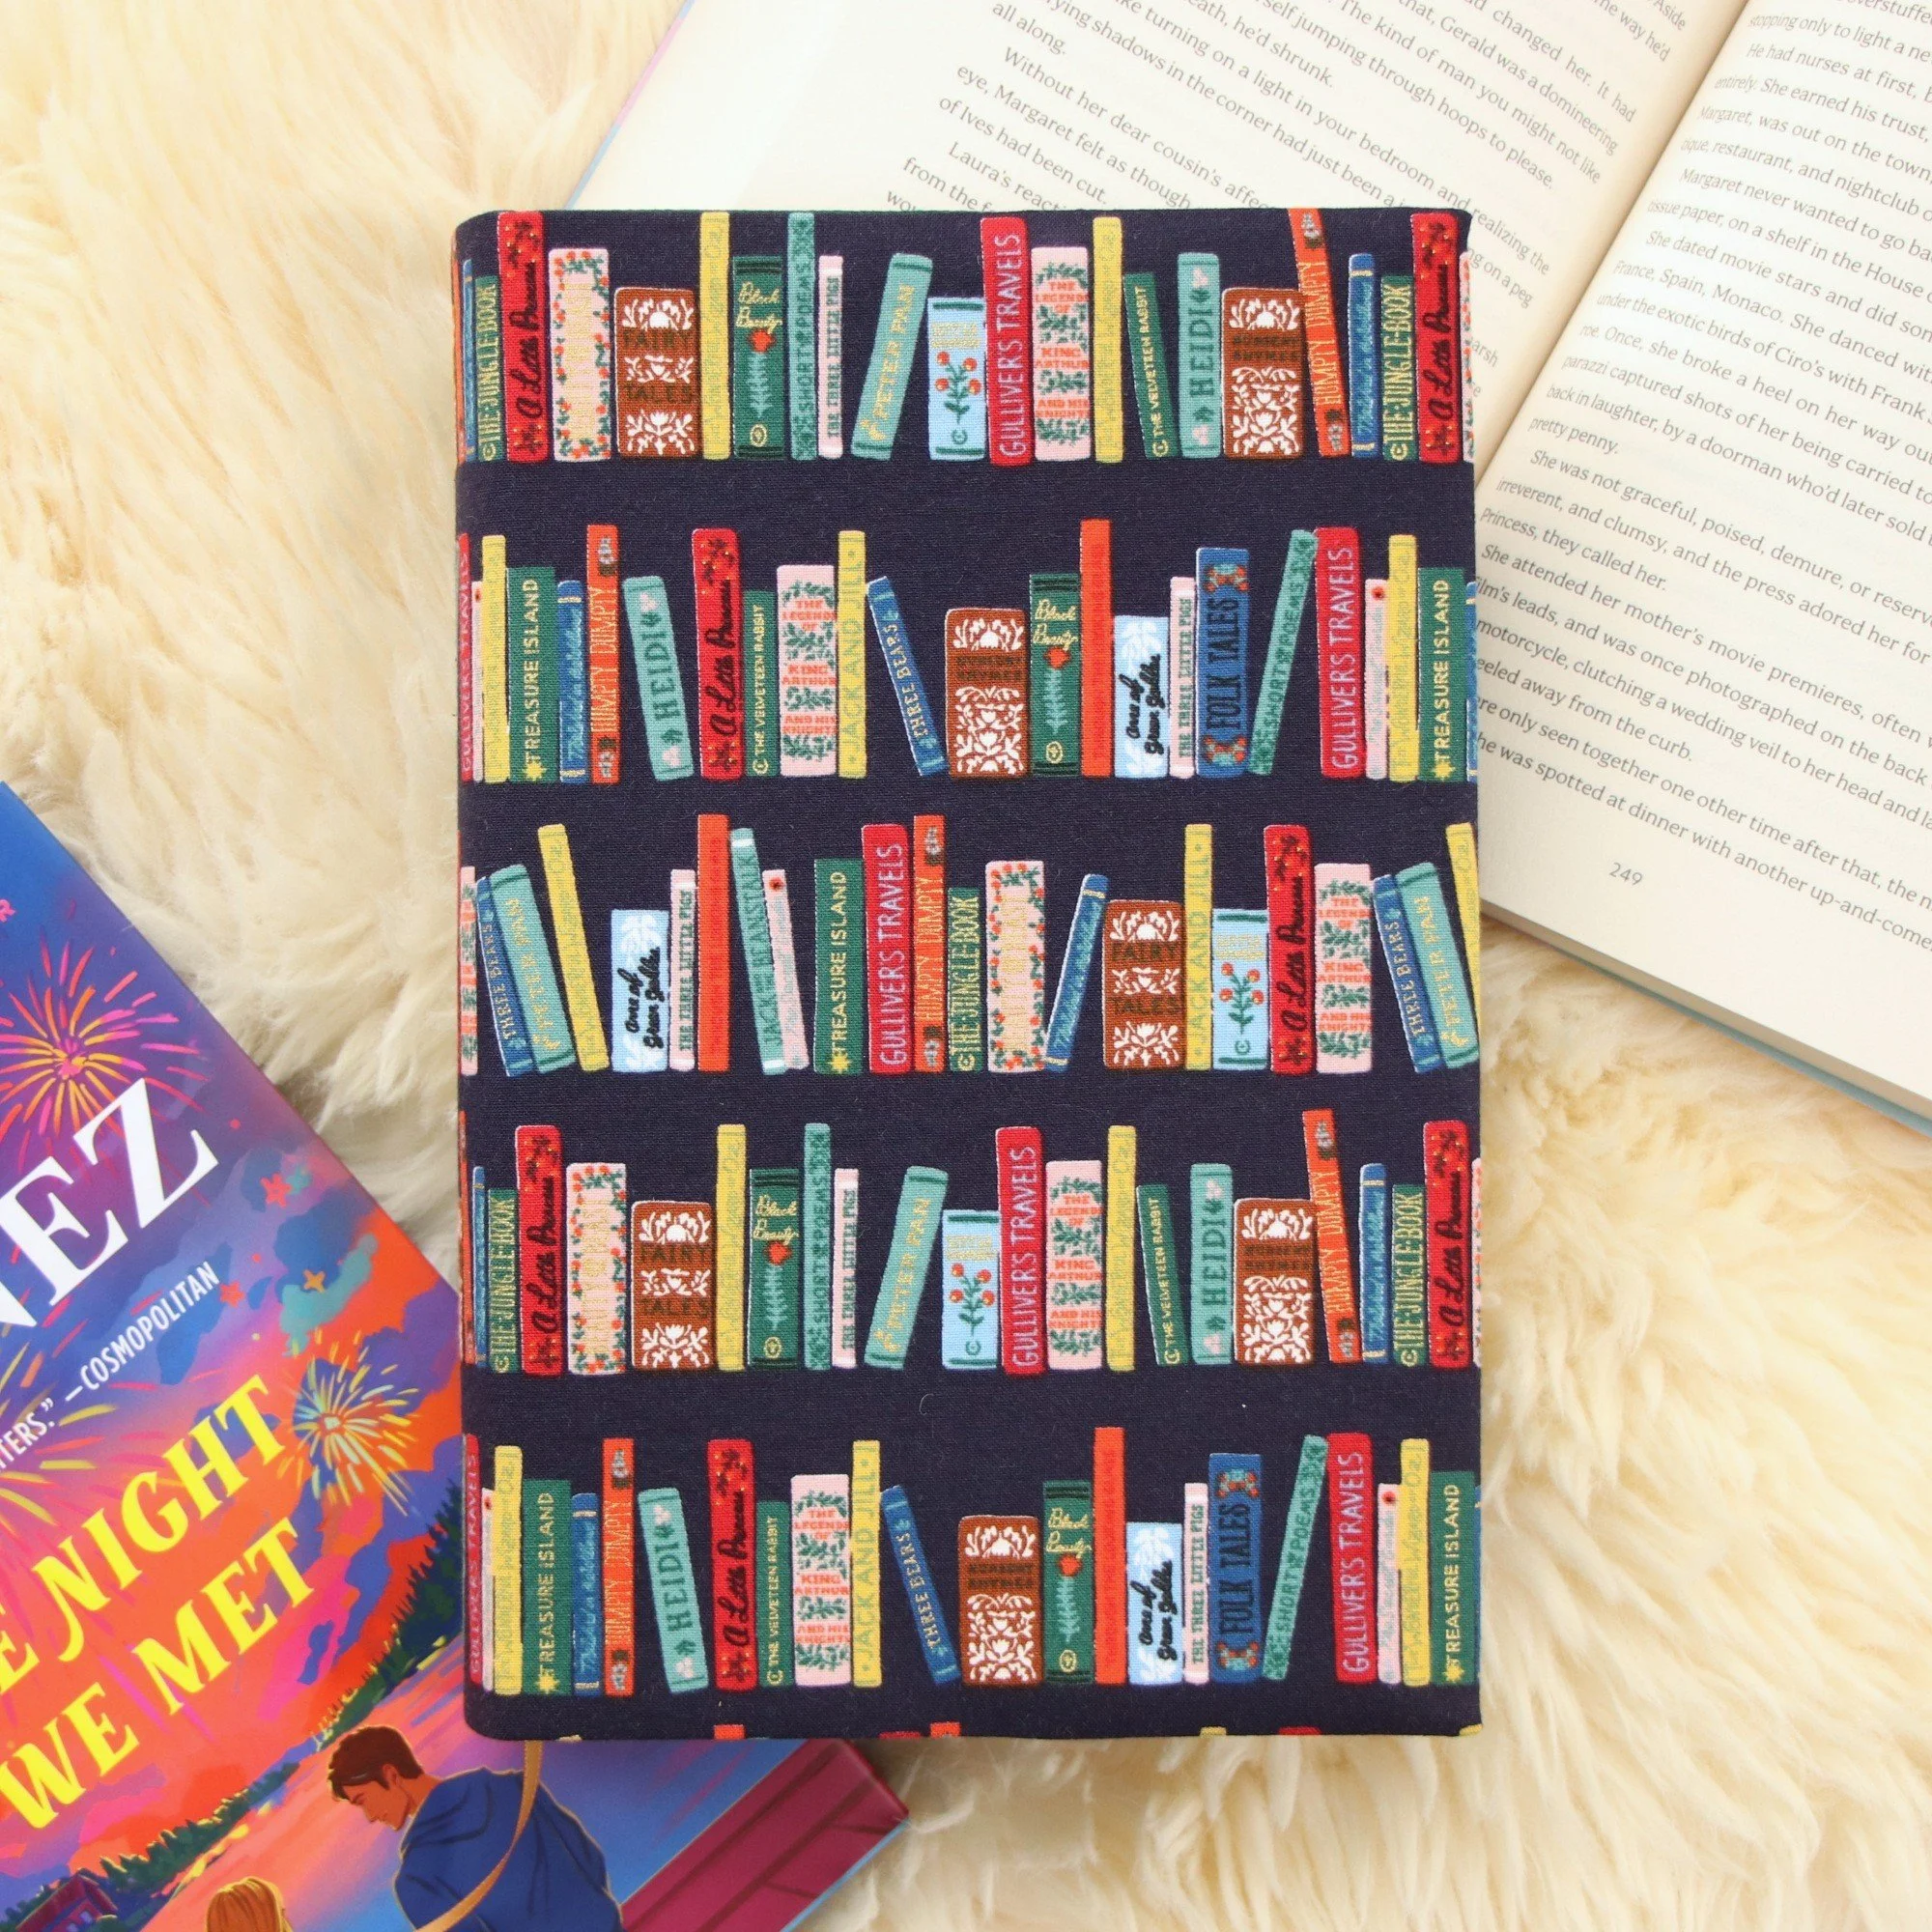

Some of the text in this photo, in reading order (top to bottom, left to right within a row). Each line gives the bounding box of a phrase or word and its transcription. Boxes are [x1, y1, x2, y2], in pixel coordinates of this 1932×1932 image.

[1006, 46, 1151, 143] Without her dear
[1369, 57, 1435, 106] through
[1437, 97, 1488, 139] hoops
[1490, 133, 1506, 152] to
[1492, 11, 1563, 62] changed
[1597, 81, 1608, 99] It
[1611, 93, 1636, 123] had
[1766, 44, 1795, 61] had
[1796, 53, 1850, 74] nurses
[1854, 69, 1872, 82] at
[939, 99, 962, 113] of
[959, 106, 994, 136] Ives
[996, 128, 1032, 157] had
[1032, 148, 1073, 184] been
[994, 84, 1072, 141] Margaret
[1075, 132, 1104, 159] felt
[1106, 155, 1127, 173] as
[994, 233, 1022, 331] TRAVELS
[1673, 237, 1898, 327] dated movie stars and did
[1188, 307, 1215, 399] HEIDI
[1542, 528, 1580, 555] they
[1581, 547, 1634, 575] called
[1560, 461, 1590, 480] was
[1591, 473, 1622, 493] not
[1850, 582, 1871, 597] or
[1327, 547, 1354, 647] TRAVELS
[1568, 503, 1603, 524] and
[1673, 546, 1711, 568] and
[1712, 559, 1743, 582] the
[1744, 576, 1796, 606] press
[1799, 600, 1866, 636] adored
[1866, 625, 1899, 650] her
[1902, 641, 1931, 664] for
[522, 579, 542, 765] TREASURE ISLAND
[644, 631, 681, 722] HEIDI
[1433, 580, 1451, 763] TREASURE ISLAND
[1481, 544, 1510, 565] She
[1511, 557, 1588, 596] attended
[1590, 584, 1622, 610] her
[1708, 639, 1765, 672] movie
[1871, 713, 1921, 743] often
[1564, 618, 1601, 640] and
[1604, 633, 1637, 657] was
[1640, 651, 1685, 676] once
[1685, 670, 1819, 736] photographed
[1820, 730, 1844, 749] on
[1849, 740, 1880, 764] the
[1883, 753, 1928, 786] back
[1500, 746, 1808, 892] was spotted at dinner with another
[877, 842, 905, 944] TRAVELS
[1609, 862, 1643, 885] 249
[830, 871, 847, 1058] TREASURE ISLAND
[1009, 1147, 1037, 1244] TRAVELS
[1202, 1216, 1228, 1308] HEIDI
[31, 1374, 286, 1662] NIGHT
[537, 1492, 555, 1569] ISLAND
[1337, 1452, 1364, 1550] TRAVELS
[654, 1544, 694, 1633] HEIDI
[1444, 1484, 1461, 1663] TREASURE ISLAND
[0, 1682, 140, 1830] WE
[131, 1517, 315, 1716] MET
